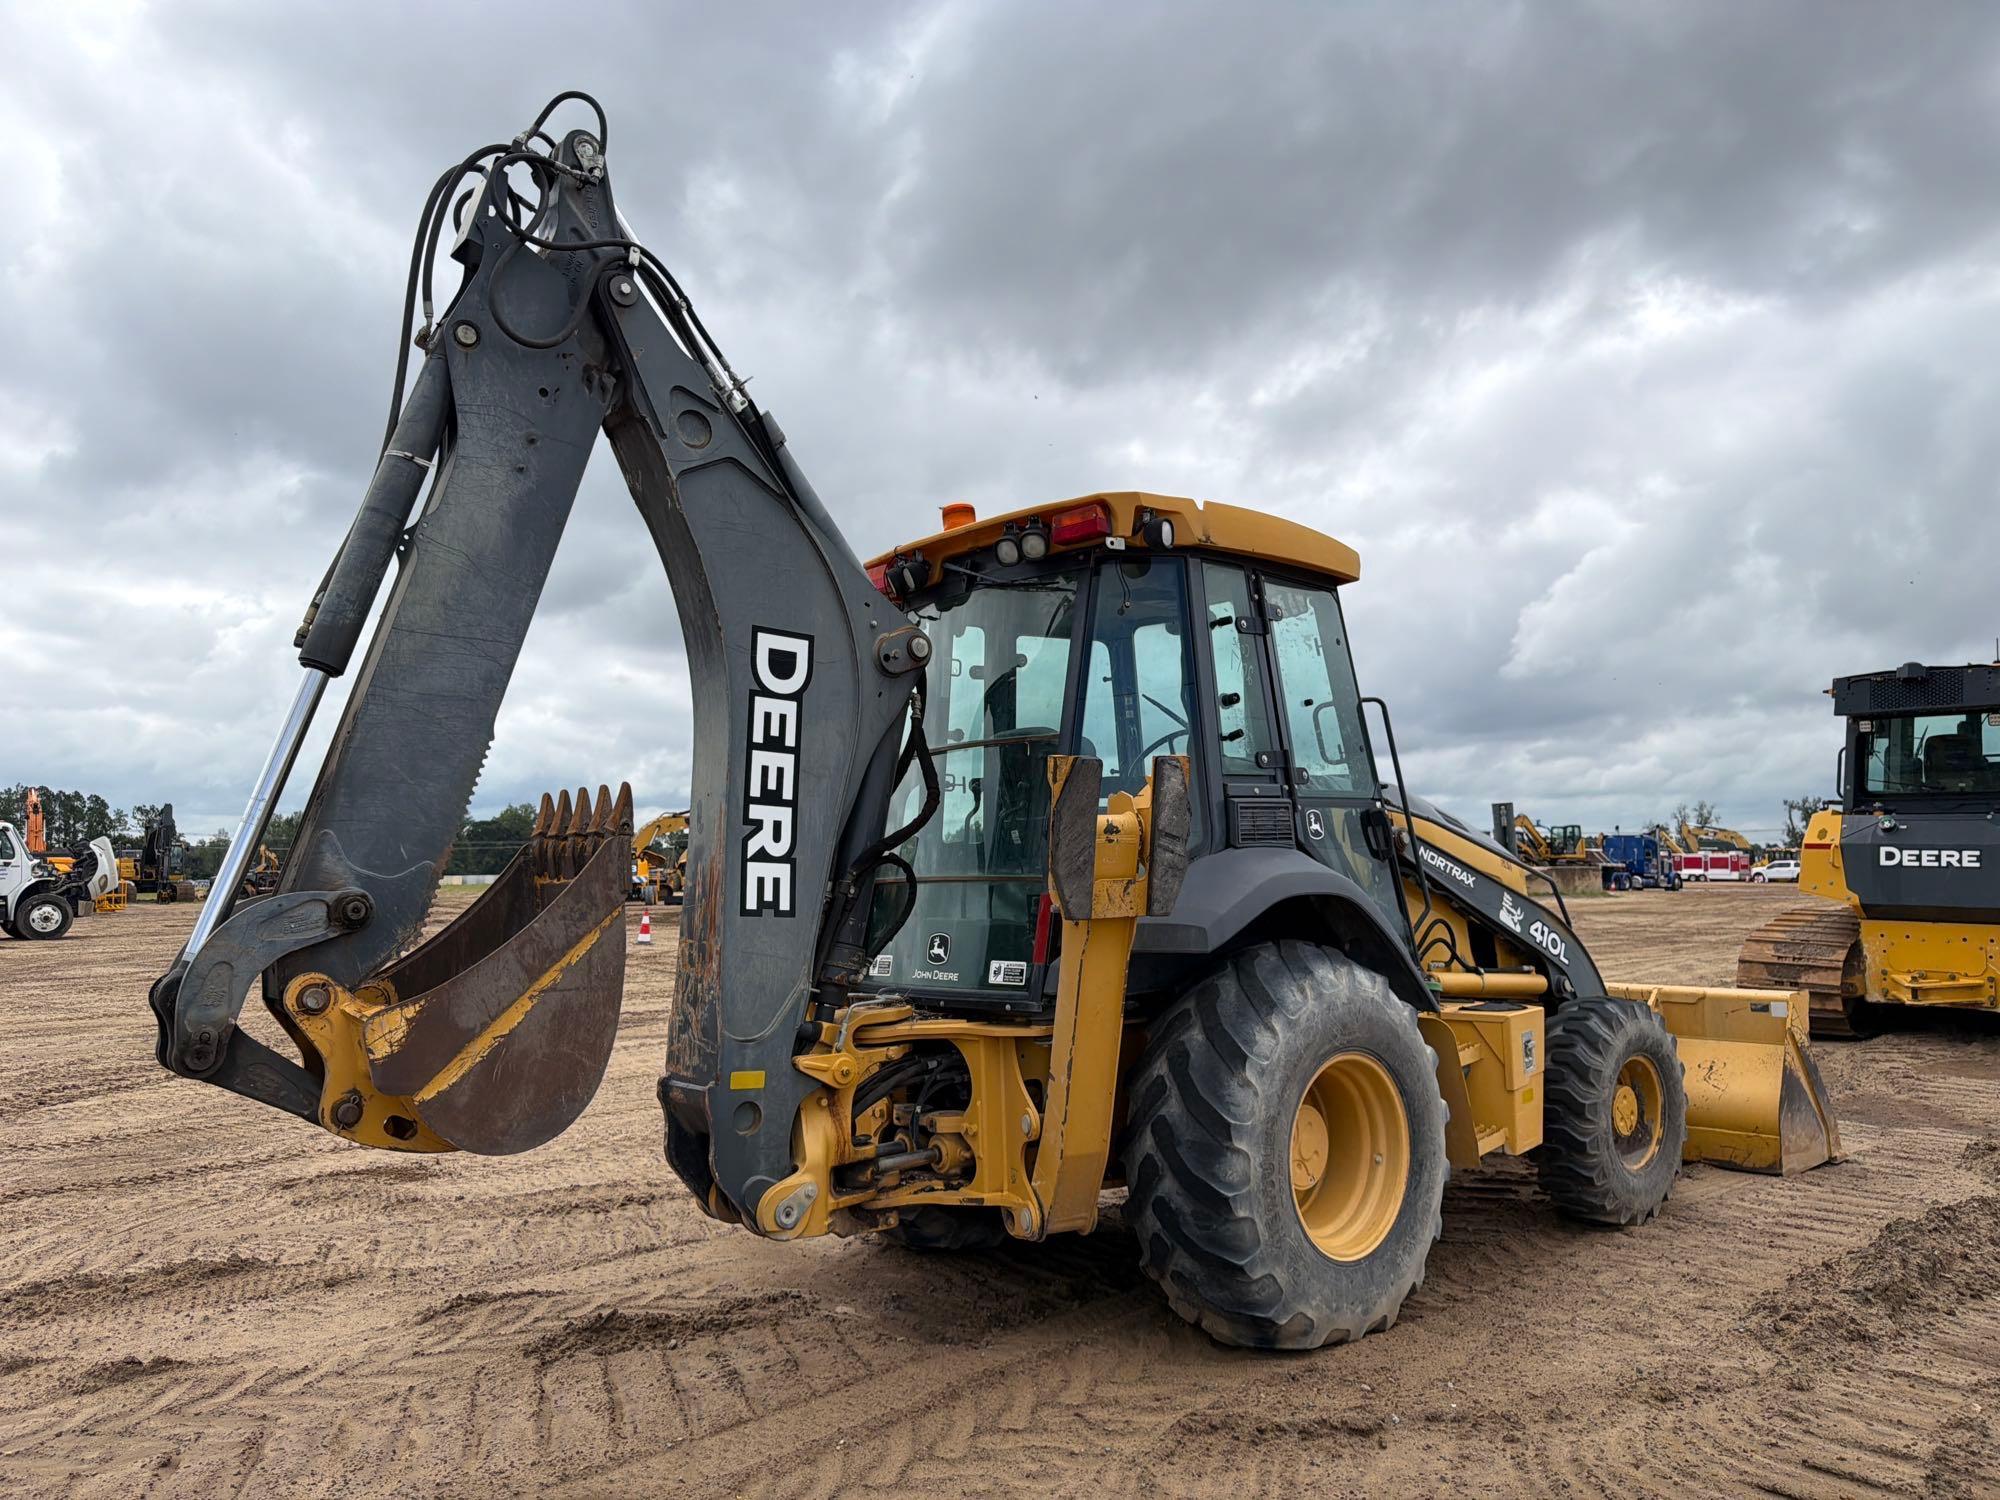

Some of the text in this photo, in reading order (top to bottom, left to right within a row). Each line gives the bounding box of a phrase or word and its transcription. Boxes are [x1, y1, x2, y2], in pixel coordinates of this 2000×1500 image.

[745, 631, 810, 911] DEERE
[1418, 846, 1476, 888] NORTRAX
[1879, 846, 1980, 867] DEERE
[1529, 920, 1570, 966] 410L
[912, 968, 959, 981] JOHN DEERE
